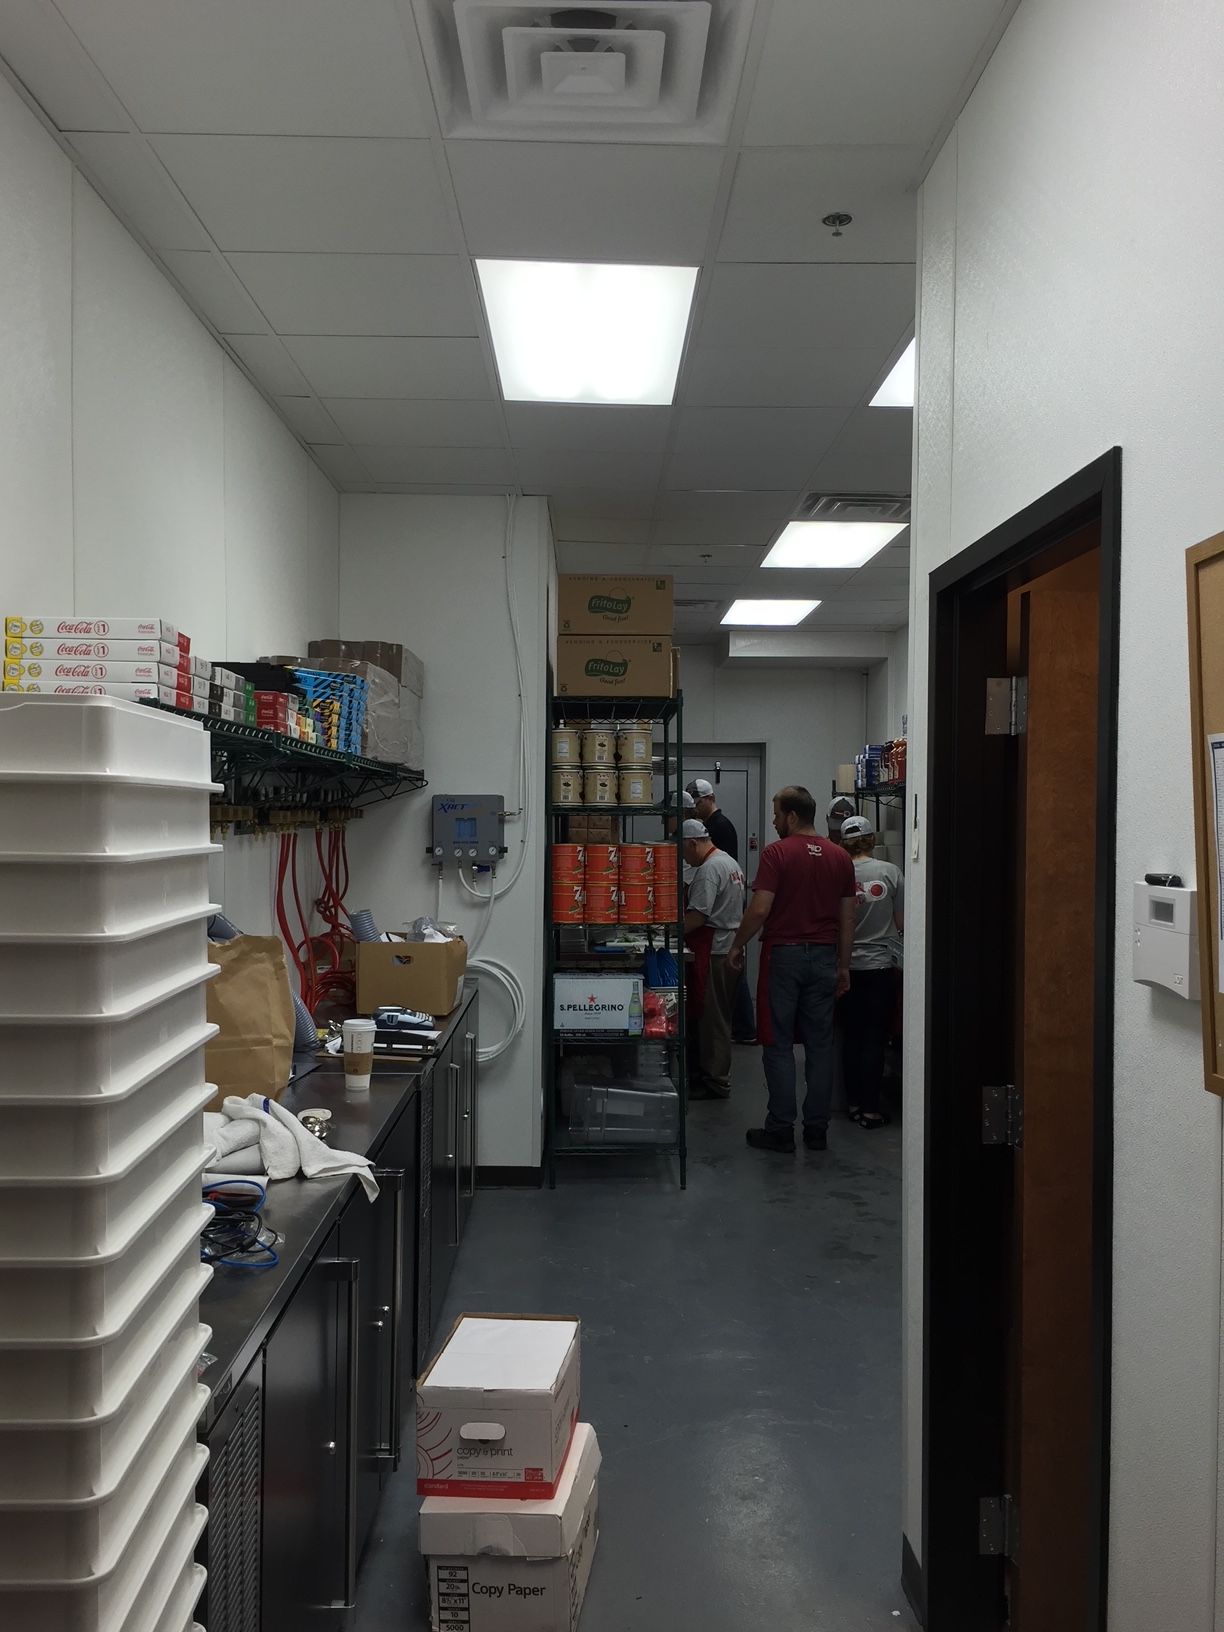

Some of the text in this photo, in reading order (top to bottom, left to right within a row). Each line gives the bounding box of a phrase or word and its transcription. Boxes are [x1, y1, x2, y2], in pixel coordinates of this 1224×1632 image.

[456, 1447, 482, 1458] copy
[490, 1447, 513, 1458] print
[471, 1582, 546, 1599] Copy Paper
